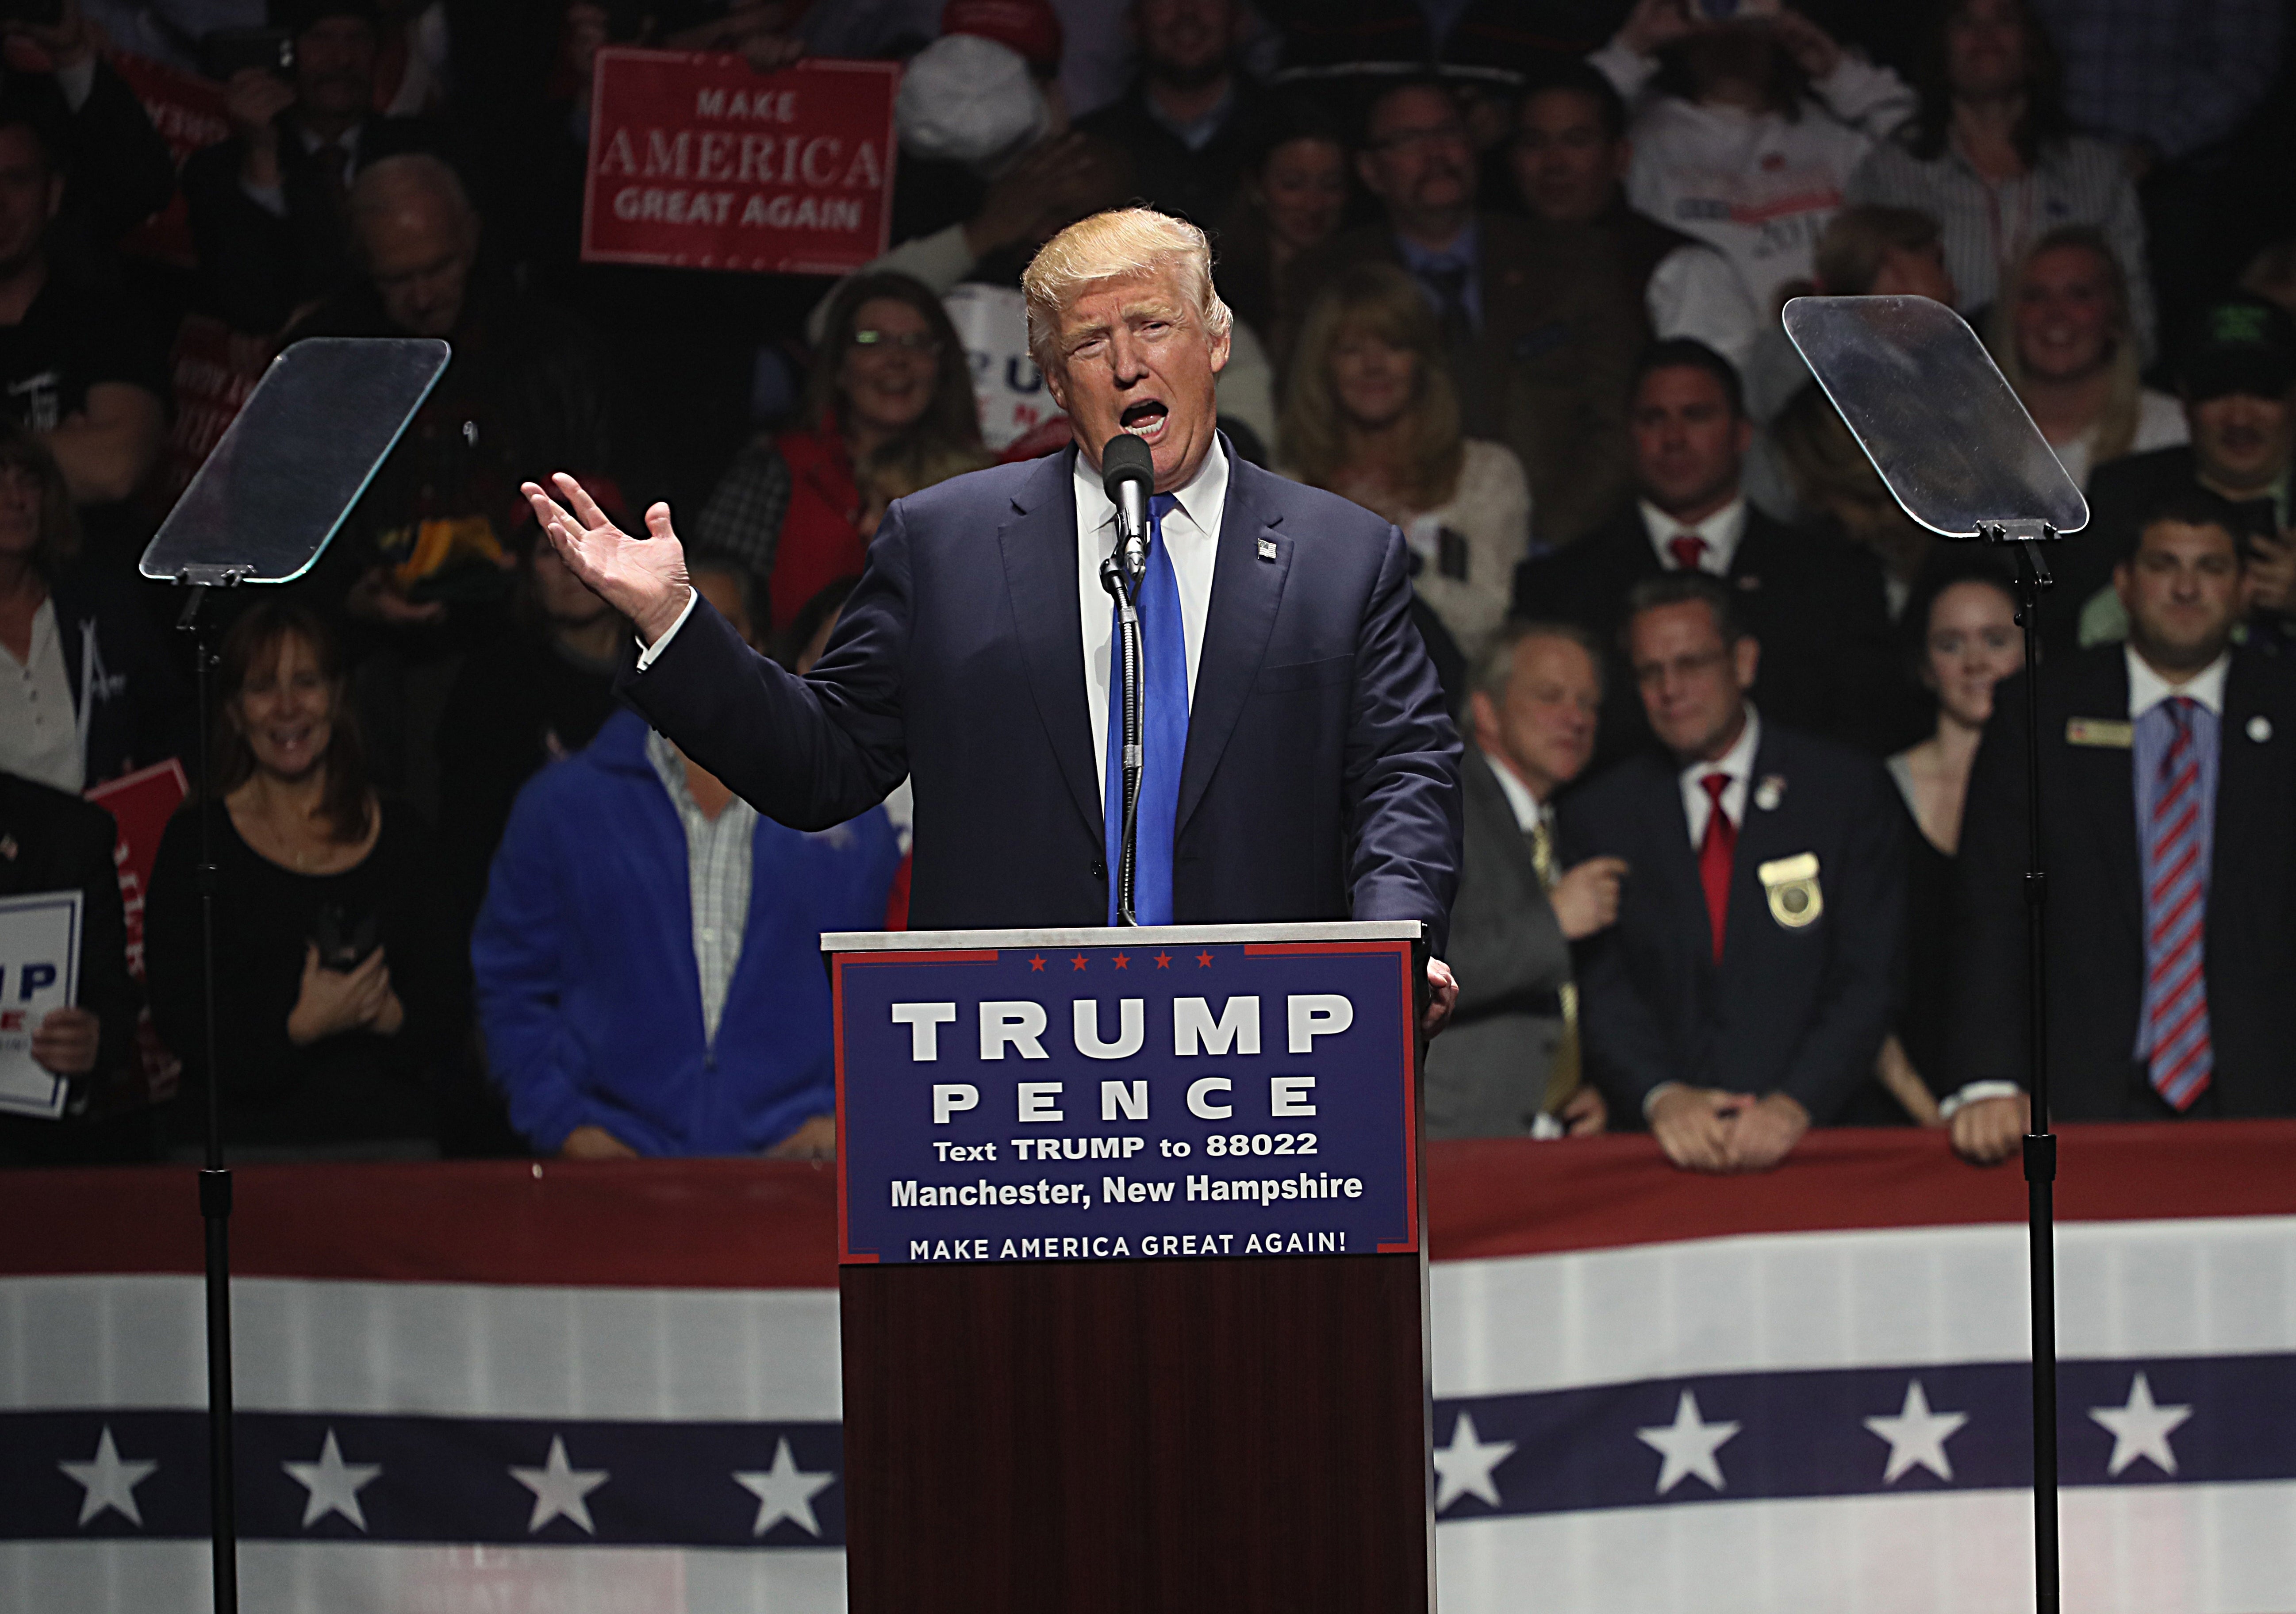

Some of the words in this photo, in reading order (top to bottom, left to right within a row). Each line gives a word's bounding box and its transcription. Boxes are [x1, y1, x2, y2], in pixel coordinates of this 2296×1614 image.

[696, 89, 794, 121] MAKE
[599, 129, 882, 188] AMERICA
[614, 188, 733, 225] GREAT
[741, 193, 861, 230] AGAIN
[891, 994, 1353, 1061] TRUMP
[933, 1076, 1316, 1124] PENCE
[933, 1141, 997, 1162] Text
[1011, 1137, 1144, 1160] TRUMP
[1160, 1139, 1191, 1157] to
[1206, 1133, 1317, 1157] 88022
[891, 1179, 1090, 1210] Manchester,
[1103, 1176, 1175, 1203] New
[1186, 1172, 1363, 1206] Hampshire
[910, 1239, 989, 1260] MAKE
[1000, 1237, 1130, 1258] AMERICA
[1141, 1234, 1233, 1256] GREAT
[1245, 1232, 1345, 1253] AGAIN!
